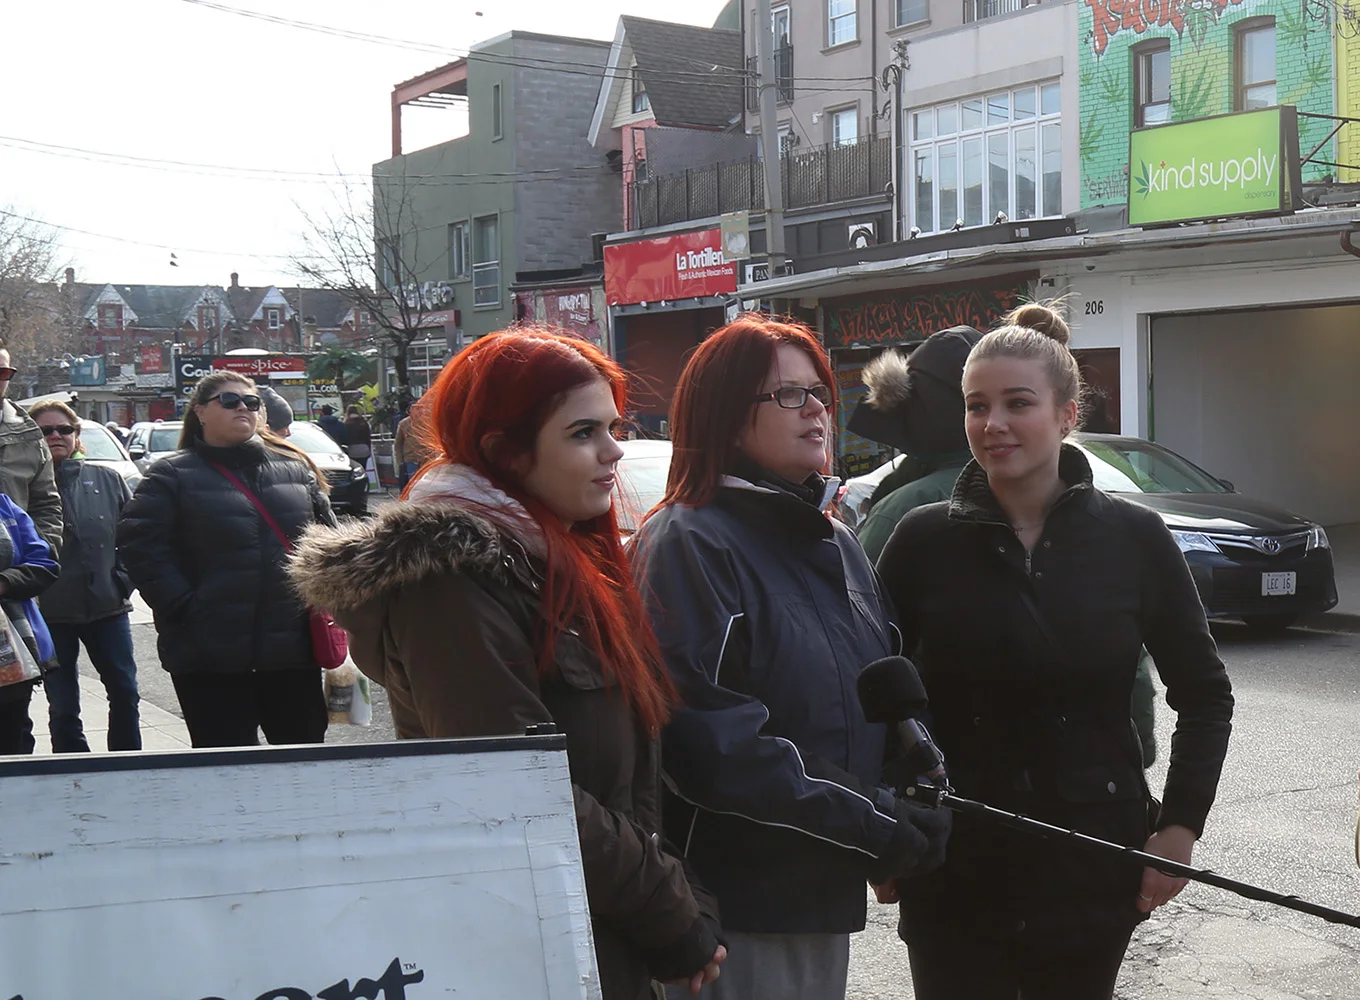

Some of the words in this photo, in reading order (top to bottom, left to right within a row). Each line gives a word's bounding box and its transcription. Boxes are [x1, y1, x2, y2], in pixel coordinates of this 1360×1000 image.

[1148, 158, 1195, 193] kind
[1198, 148, 1277, 191] supply
[1244, 190, 1277, 200] dispensary
[676, 252, 687, 271] La
[687, 246, 730, 269] Tortilleri
[1085, 300, 1104, 315] 206
[250, 359, 290, 371] spice
